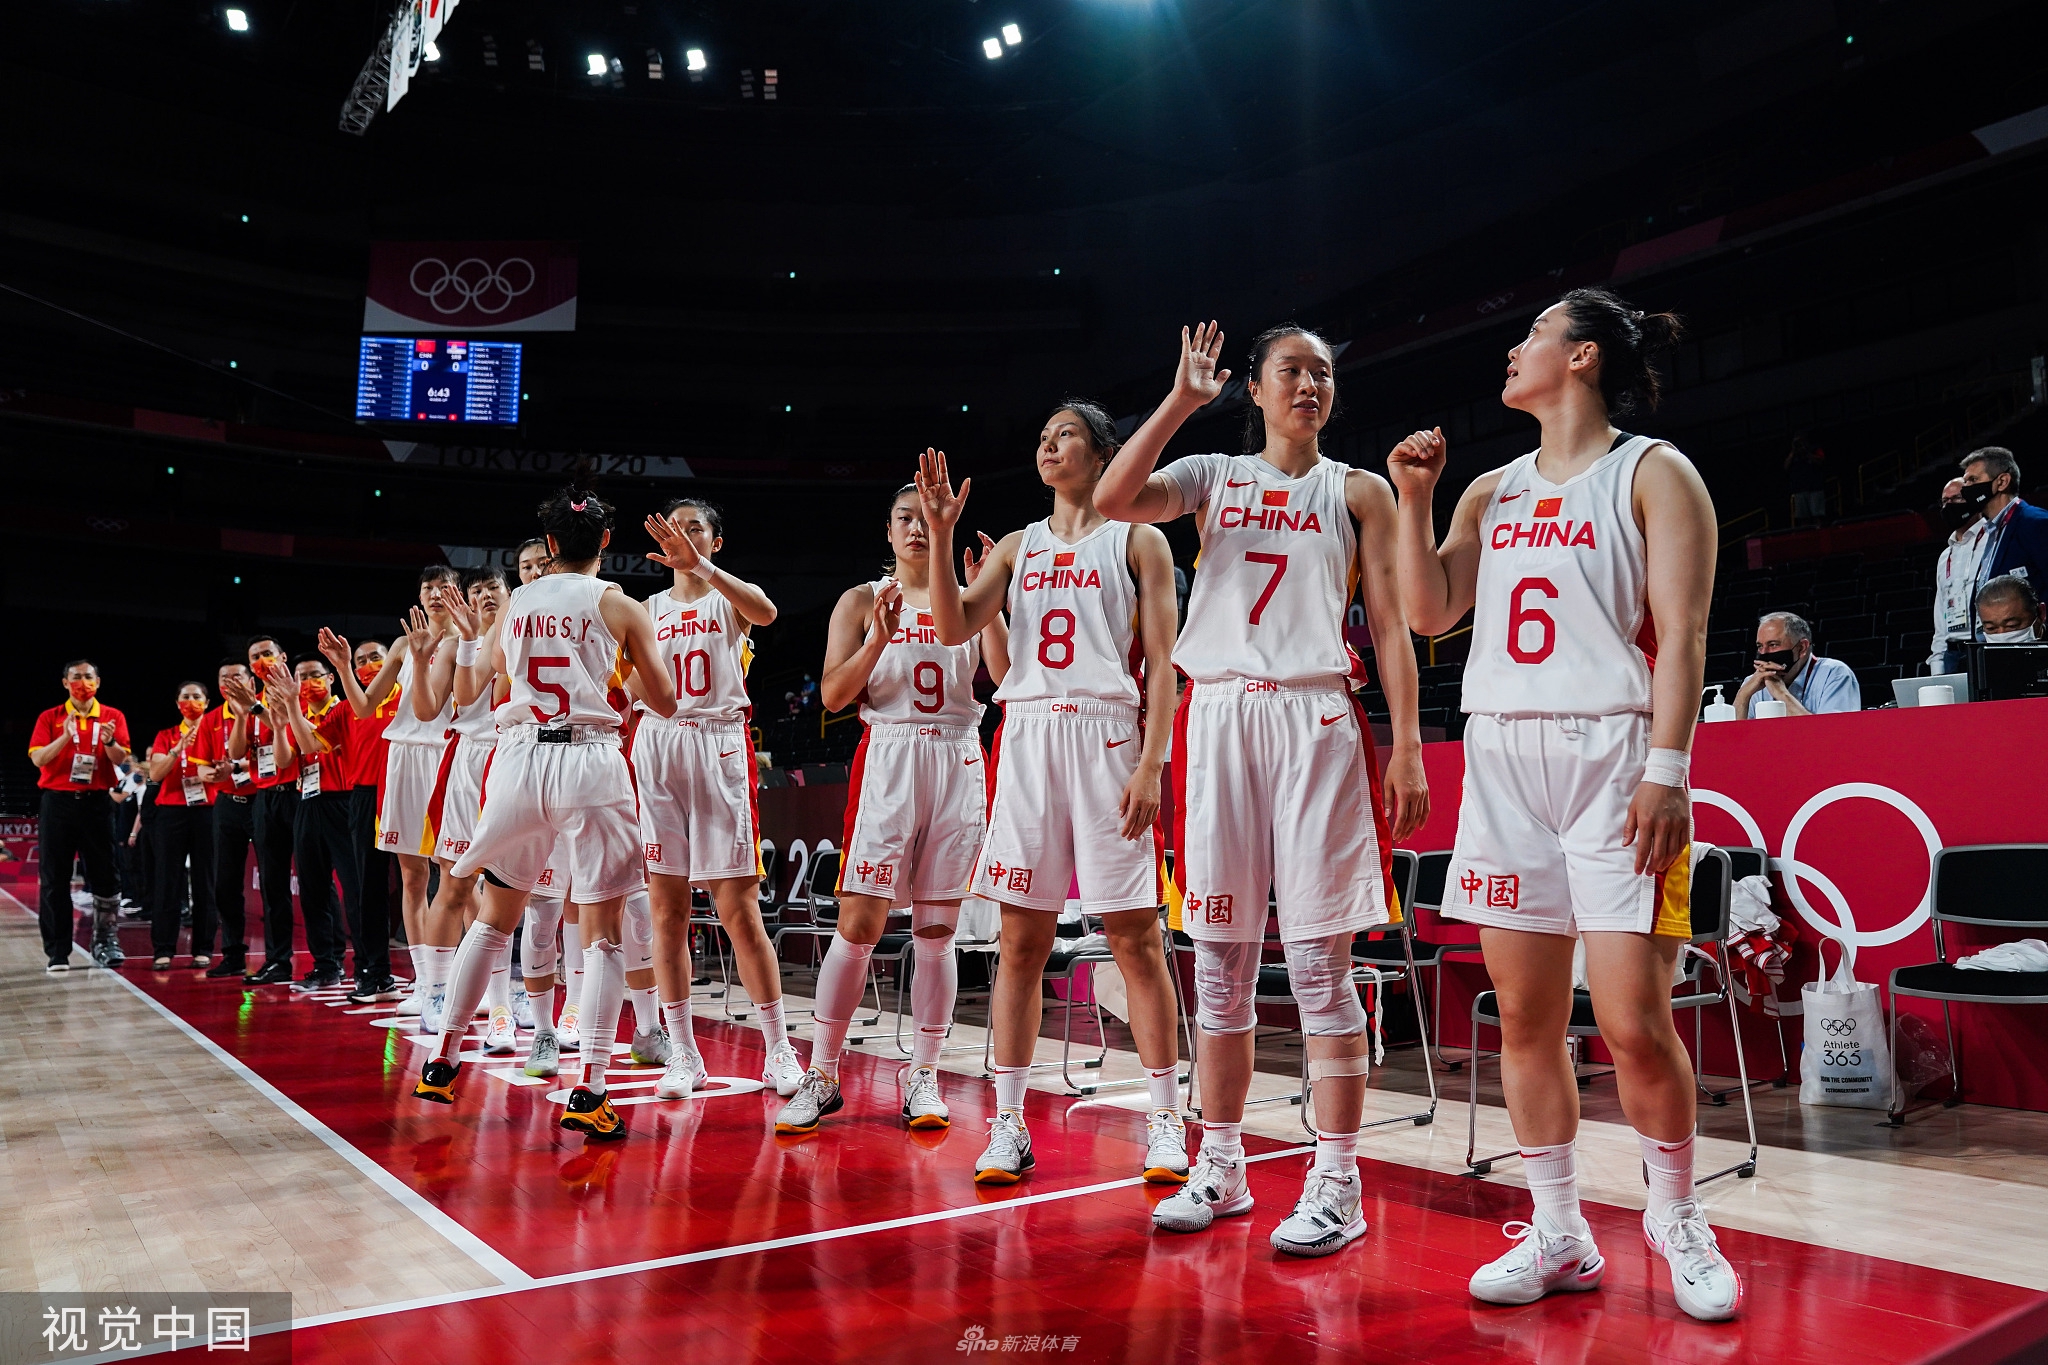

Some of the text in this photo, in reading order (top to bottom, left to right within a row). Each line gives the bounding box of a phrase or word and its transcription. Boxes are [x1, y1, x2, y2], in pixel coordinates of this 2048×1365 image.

[421, 360, 429, 371] 0
[452, 361, 460, 372] 0
[427, 387, 450, 397] 6:43
[433, 443, 552, 472] TOKYO
[1219, 506, 1322, 533] CHINA
[1491, 520, 1597, 550] CHINA
[1022, 569, 1102, 592] CHINA
[1245, 551, 1288, 625] 7
[513, 615, 556, 639] WANG
[657, 619, 722, 641] CHINA
[1507, 577, 1559, 664] 6
[889, 628, 938, 644] CHI
[1037, 608, 1076, 670] 8
[672, 648, 711, 700] 10
[527, 656, 570, 723] 5
[913, 661, 945, 714] 9
[1246, 682, 1277, 693] CHN
[1051, 703, 1078, 713] CHN
[678, 720, 699, 728] CHN
[919, 728, 941, 736] CHN
[0, 823, 32, 835] KYO
[444, 837, 471, 854] 中国
[645, 843, 662, 862] 国
[537, 868, 553, 886] 国
[856, 860, 893, 886] 中国
[988, 860, 1033, 894] 中国
[1460, 869, 1520, 910] 中国
[1187, 891, 1233, 924] 中国
[1823, 1040, 1860, 1049] Athlete
[1823, 1050, 1861, 1066] 365
